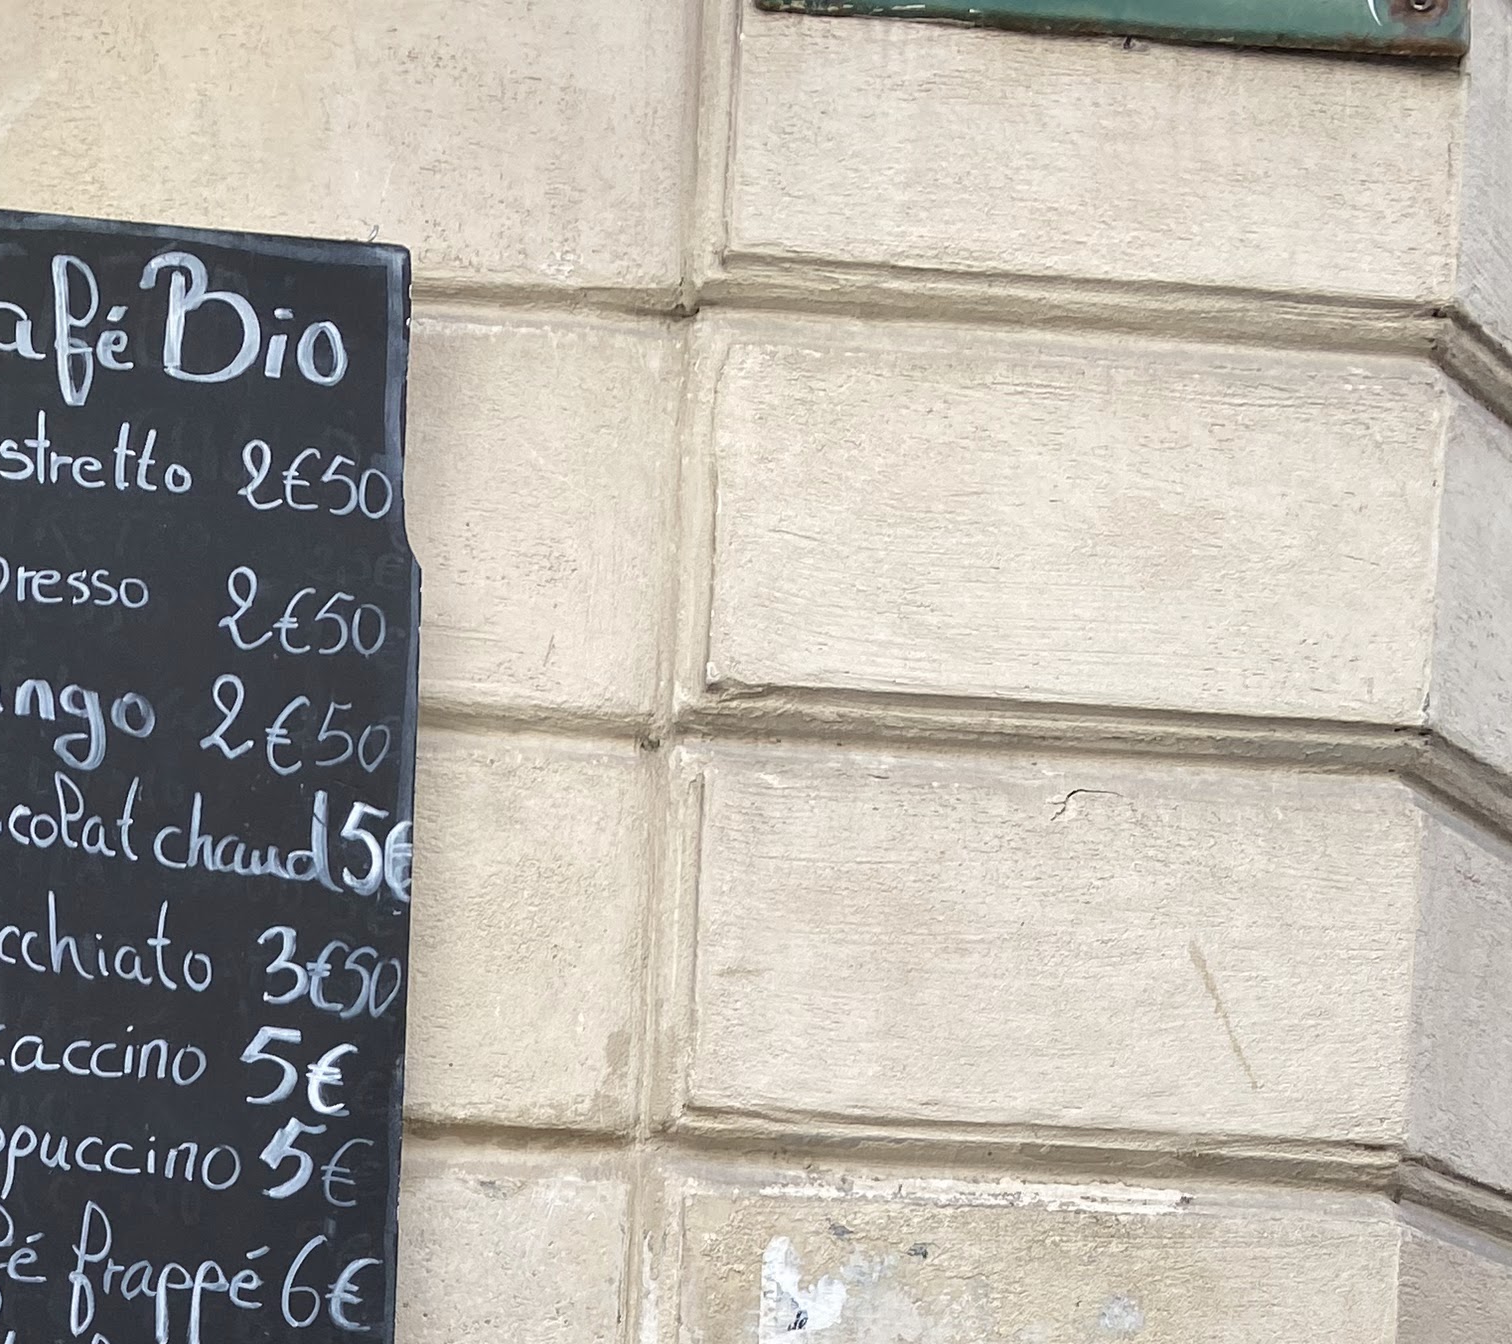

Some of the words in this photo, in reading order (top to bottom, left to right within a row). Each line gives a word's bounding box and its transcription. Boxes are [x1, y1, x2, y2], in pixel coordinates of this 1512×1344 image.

[139, 251, 349, 385] Bio
[238, 439, 392, 518] 2€50
[219, 567, 385, 655] 2€50
[199, 675, 391, 775] 2€50
[153, 791, 344, 893] chaud
[340, 801, 412, 902] 5€
[257, 926, 402, 1020] 3€50
[240, 1026, 359, 1115] 5€
[259, 1118, 374, 1207] 5€
[281, 1235, 382, 1331] 6€
